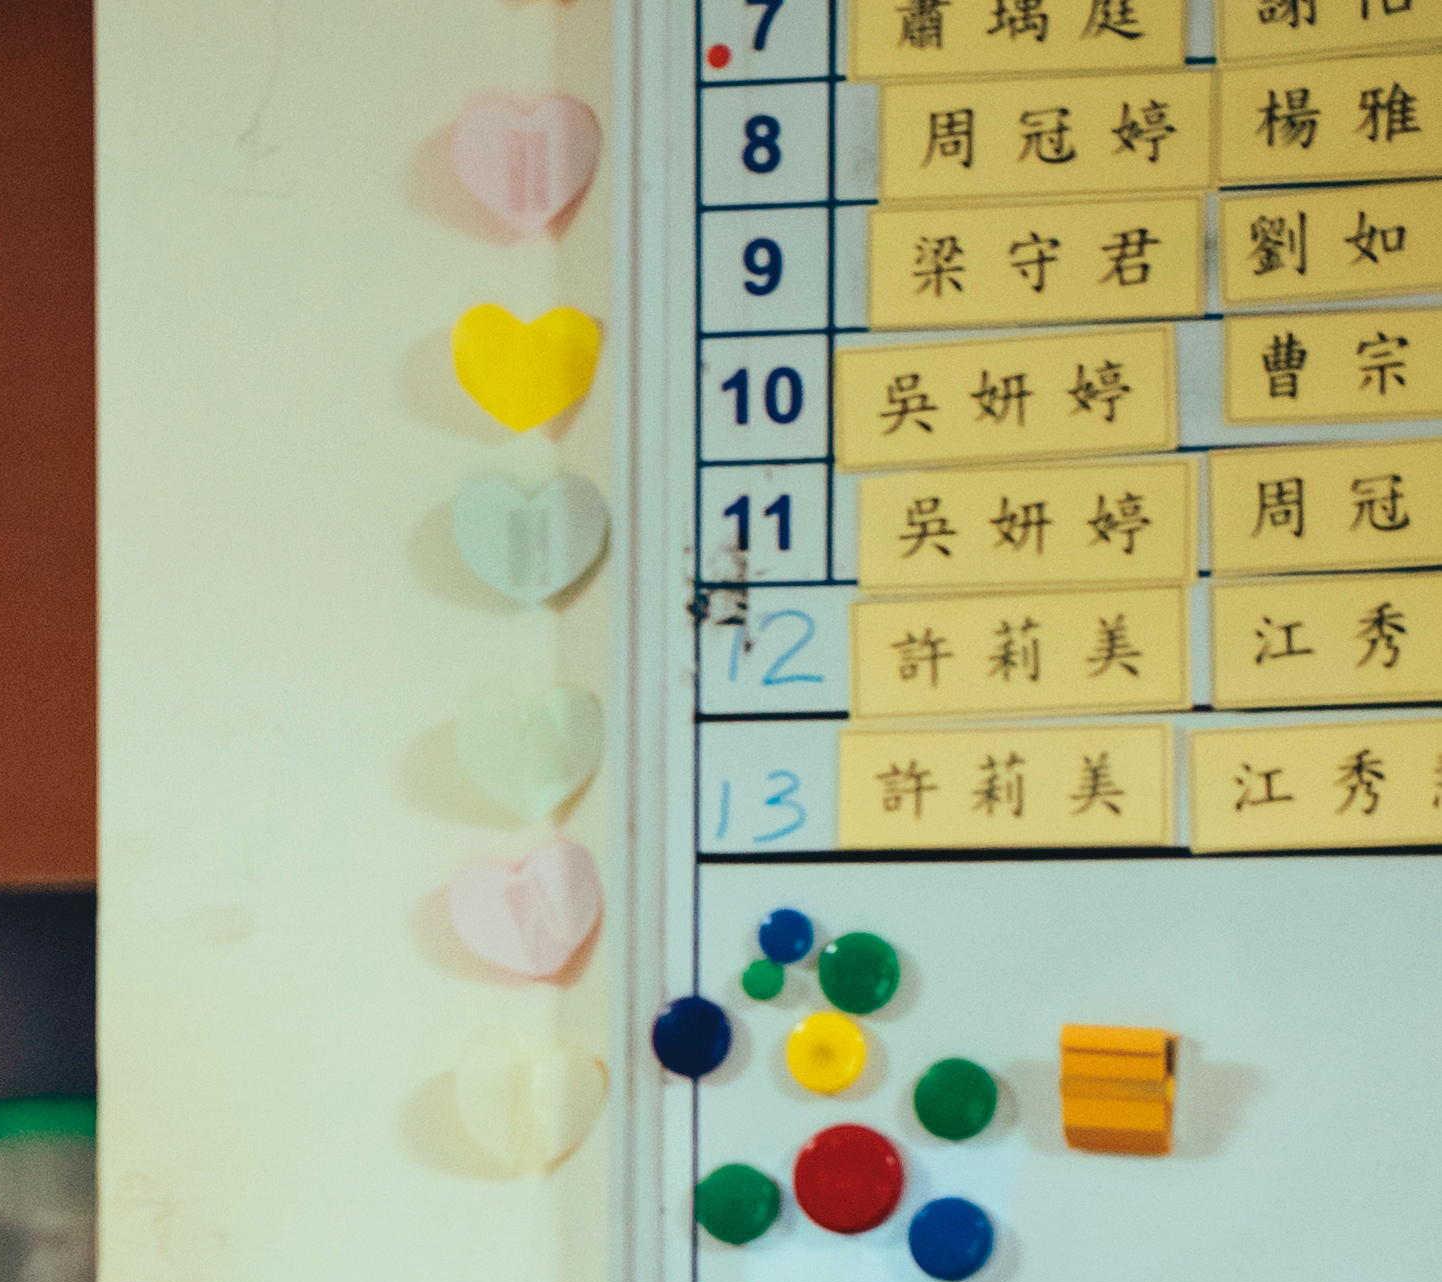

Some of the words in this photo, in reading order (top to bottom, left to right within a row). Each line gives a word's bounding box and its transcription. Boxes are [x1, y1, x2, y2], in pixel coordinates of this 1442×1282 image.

[745, 0, 785, 51] 7
[743, 115, 781, 173] 8
[919, 98, 1176, 169] 周冠婷
[1255, 82, 1422, 149] 楊雅
[744, 238, 782, 295] 9
[912, 226, 1161, 298] 梁守君
[1245, 210, 1406, 276] 劉如
[722, 367, 803, 425] 10
[1262, 331, 1409, 399] 曹宗
[724, 495, 791, 551] 11
[1249, 474, 1411, 539] 周冠
[728, 609, 825, 686] 12
[889, 612, 1143, 689] 許莉美
[1254, 601, 1408, 669] 江秀
[716, 770, 808, 844] 13
[874, 750, 1125, 820] 許莉美
[1234, 748, 1442, 818] 江秀
